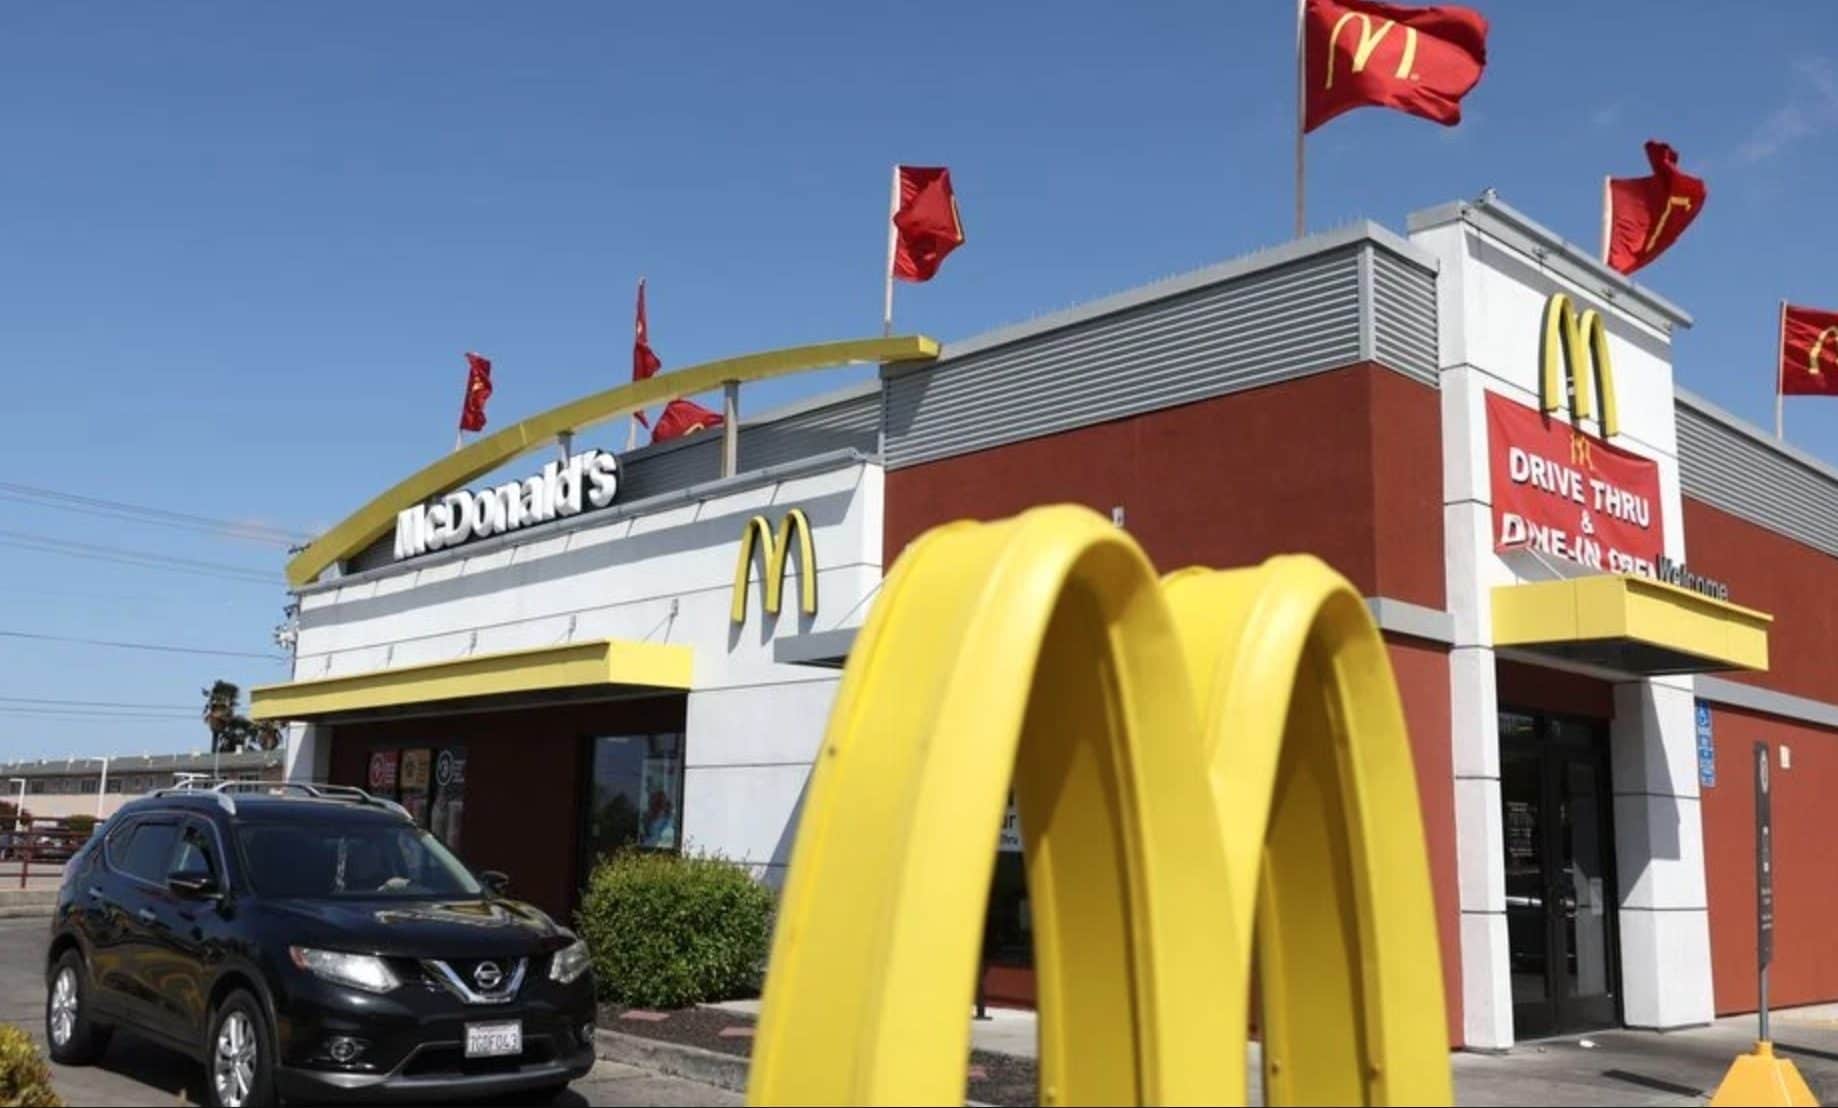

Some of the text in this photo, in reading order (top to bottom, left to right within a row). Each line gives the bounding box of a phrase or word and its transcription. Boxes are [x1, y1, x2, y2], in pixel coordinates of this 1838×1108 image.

[393, 448, 619, 560] McDonald's
[1509, 446, 1650, 529] DRIVE THRU
[1581, 508, 1595, 536] &
[1656, 554, 1729, 602] Welcome
